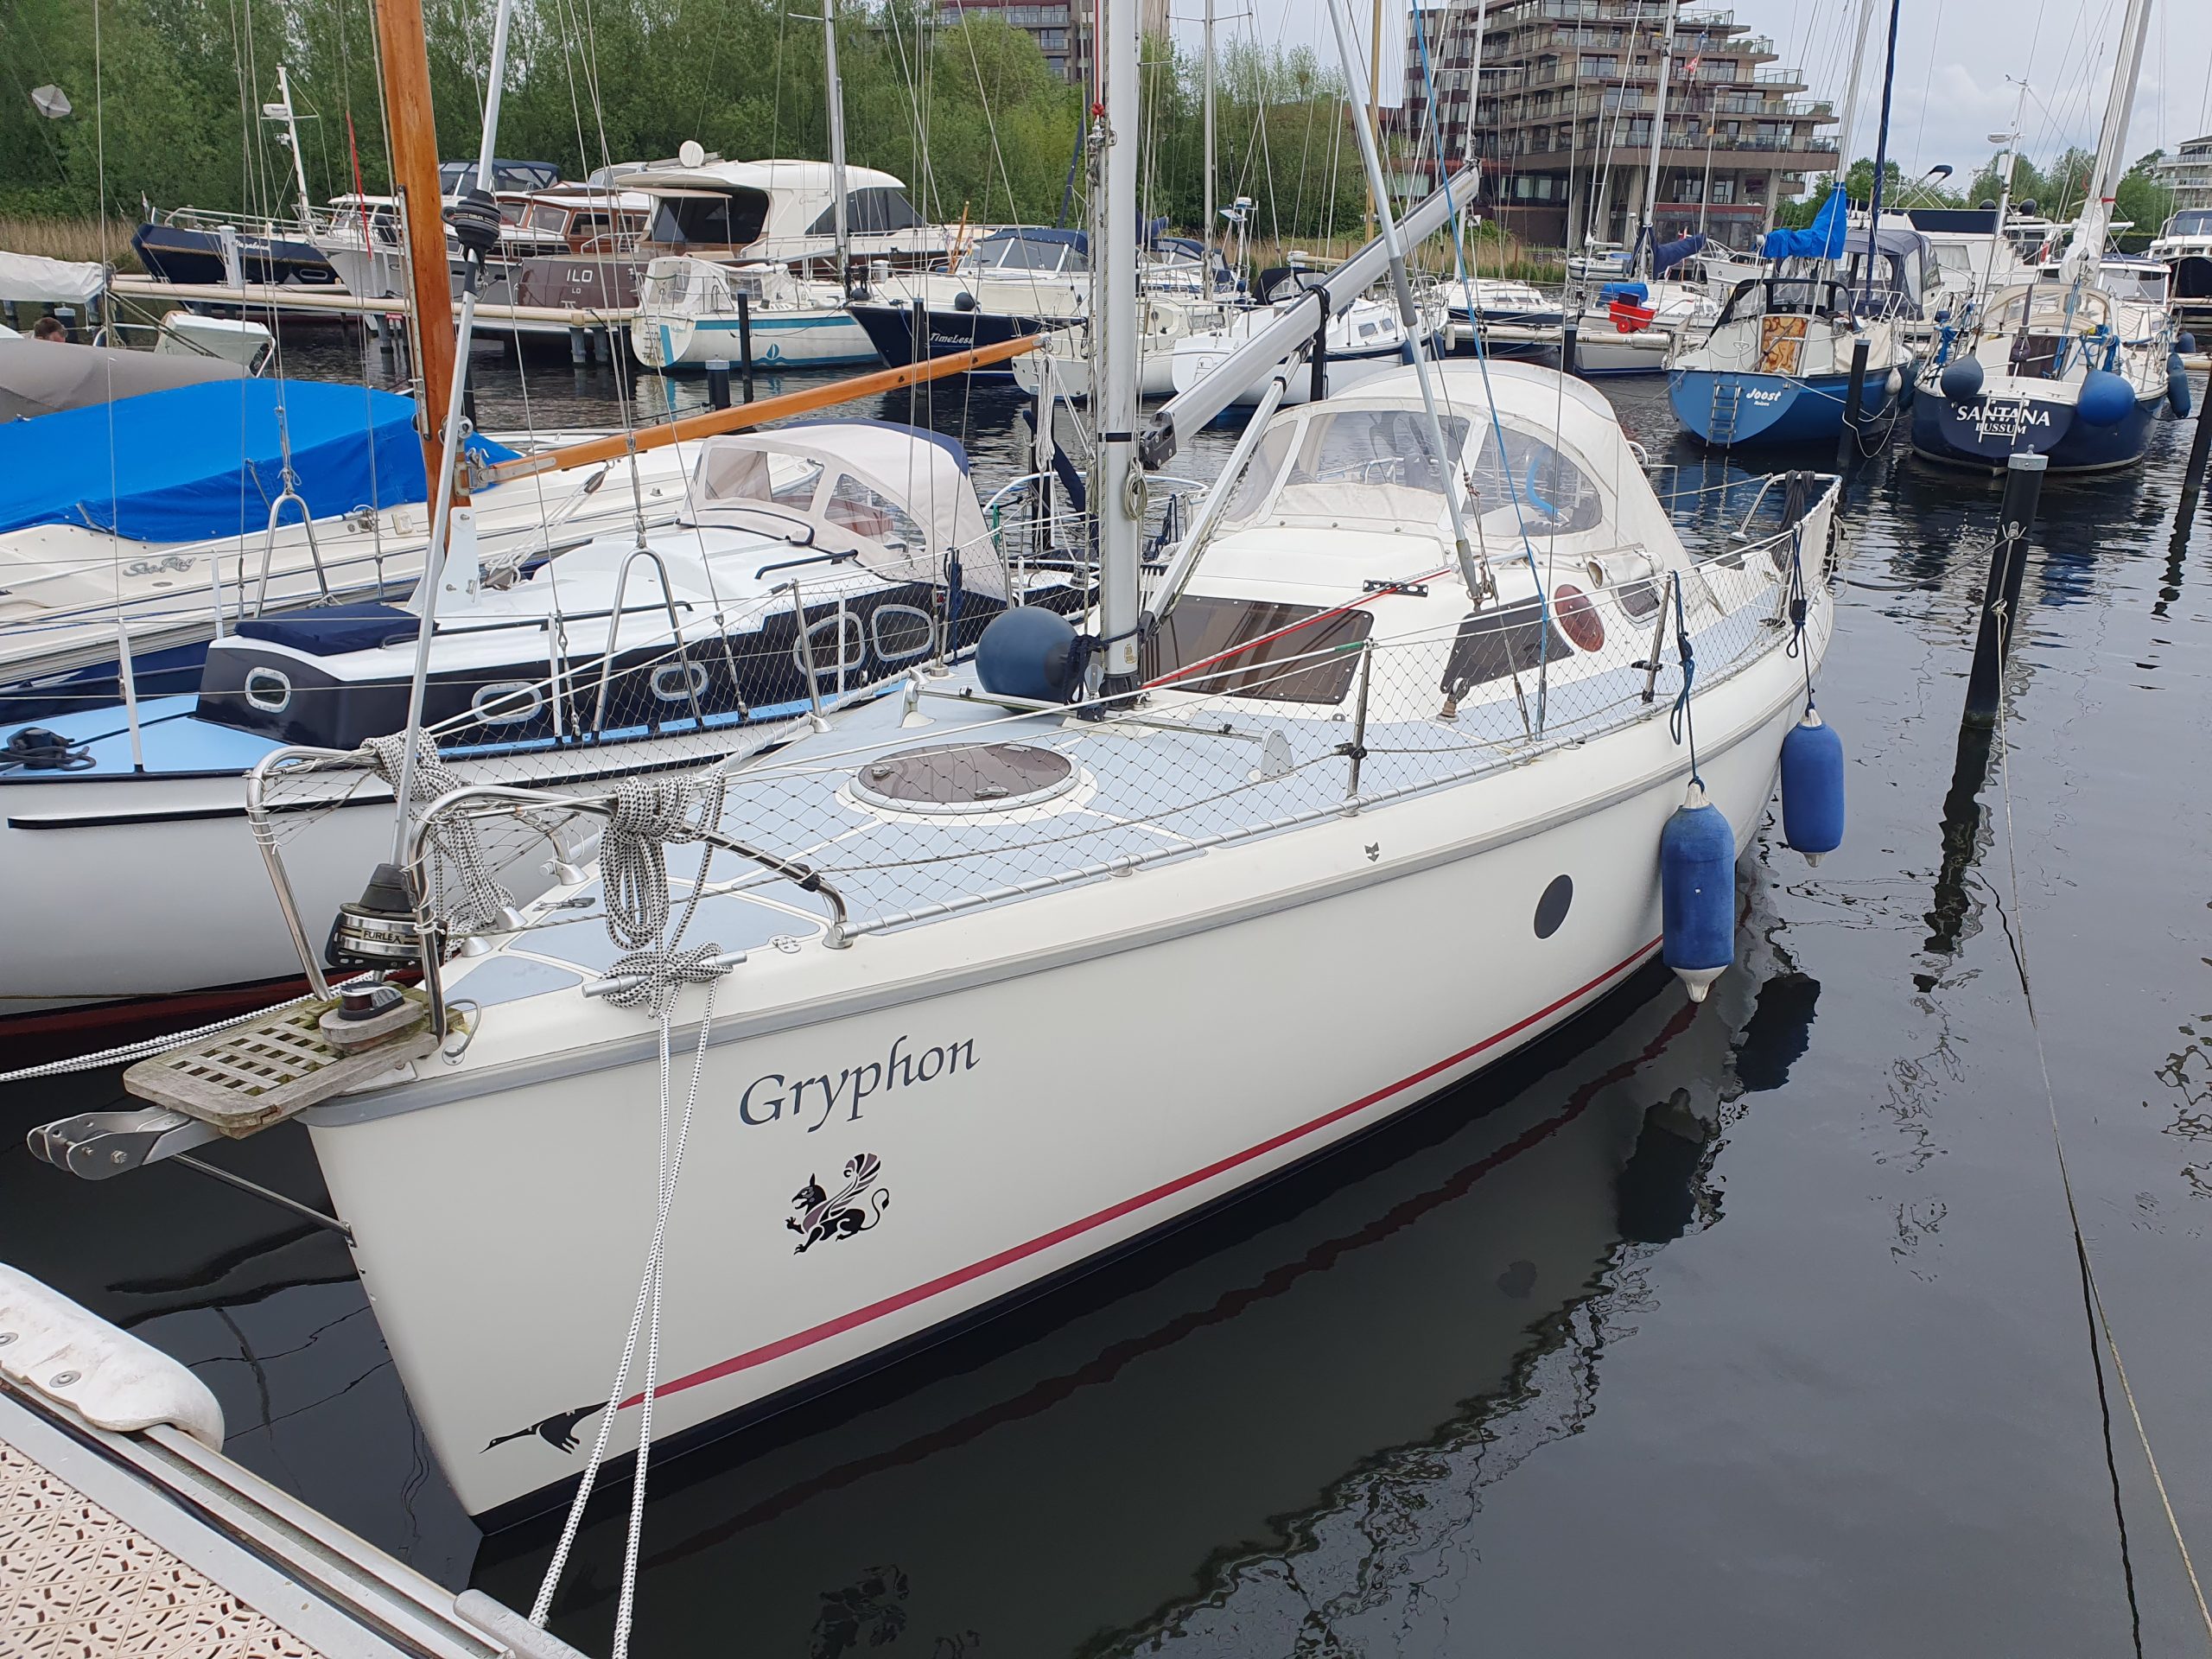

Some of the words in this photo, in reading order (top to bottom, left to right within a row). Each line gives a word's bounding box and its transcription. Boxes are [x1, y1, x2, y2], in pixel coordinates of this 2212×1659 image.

[567, 269, 594, 283] ILO
[930, 332, 975, 344] TimeLess
[1745, 388, 1782, 401] Joost
[1956, 405, 2050, 427] SANTANA
[1975, 422, 2027, 435] BUSSUM
[363, 930, 402, 944] FURLEX
[740, 1034, 981, 1134] Gryphon
